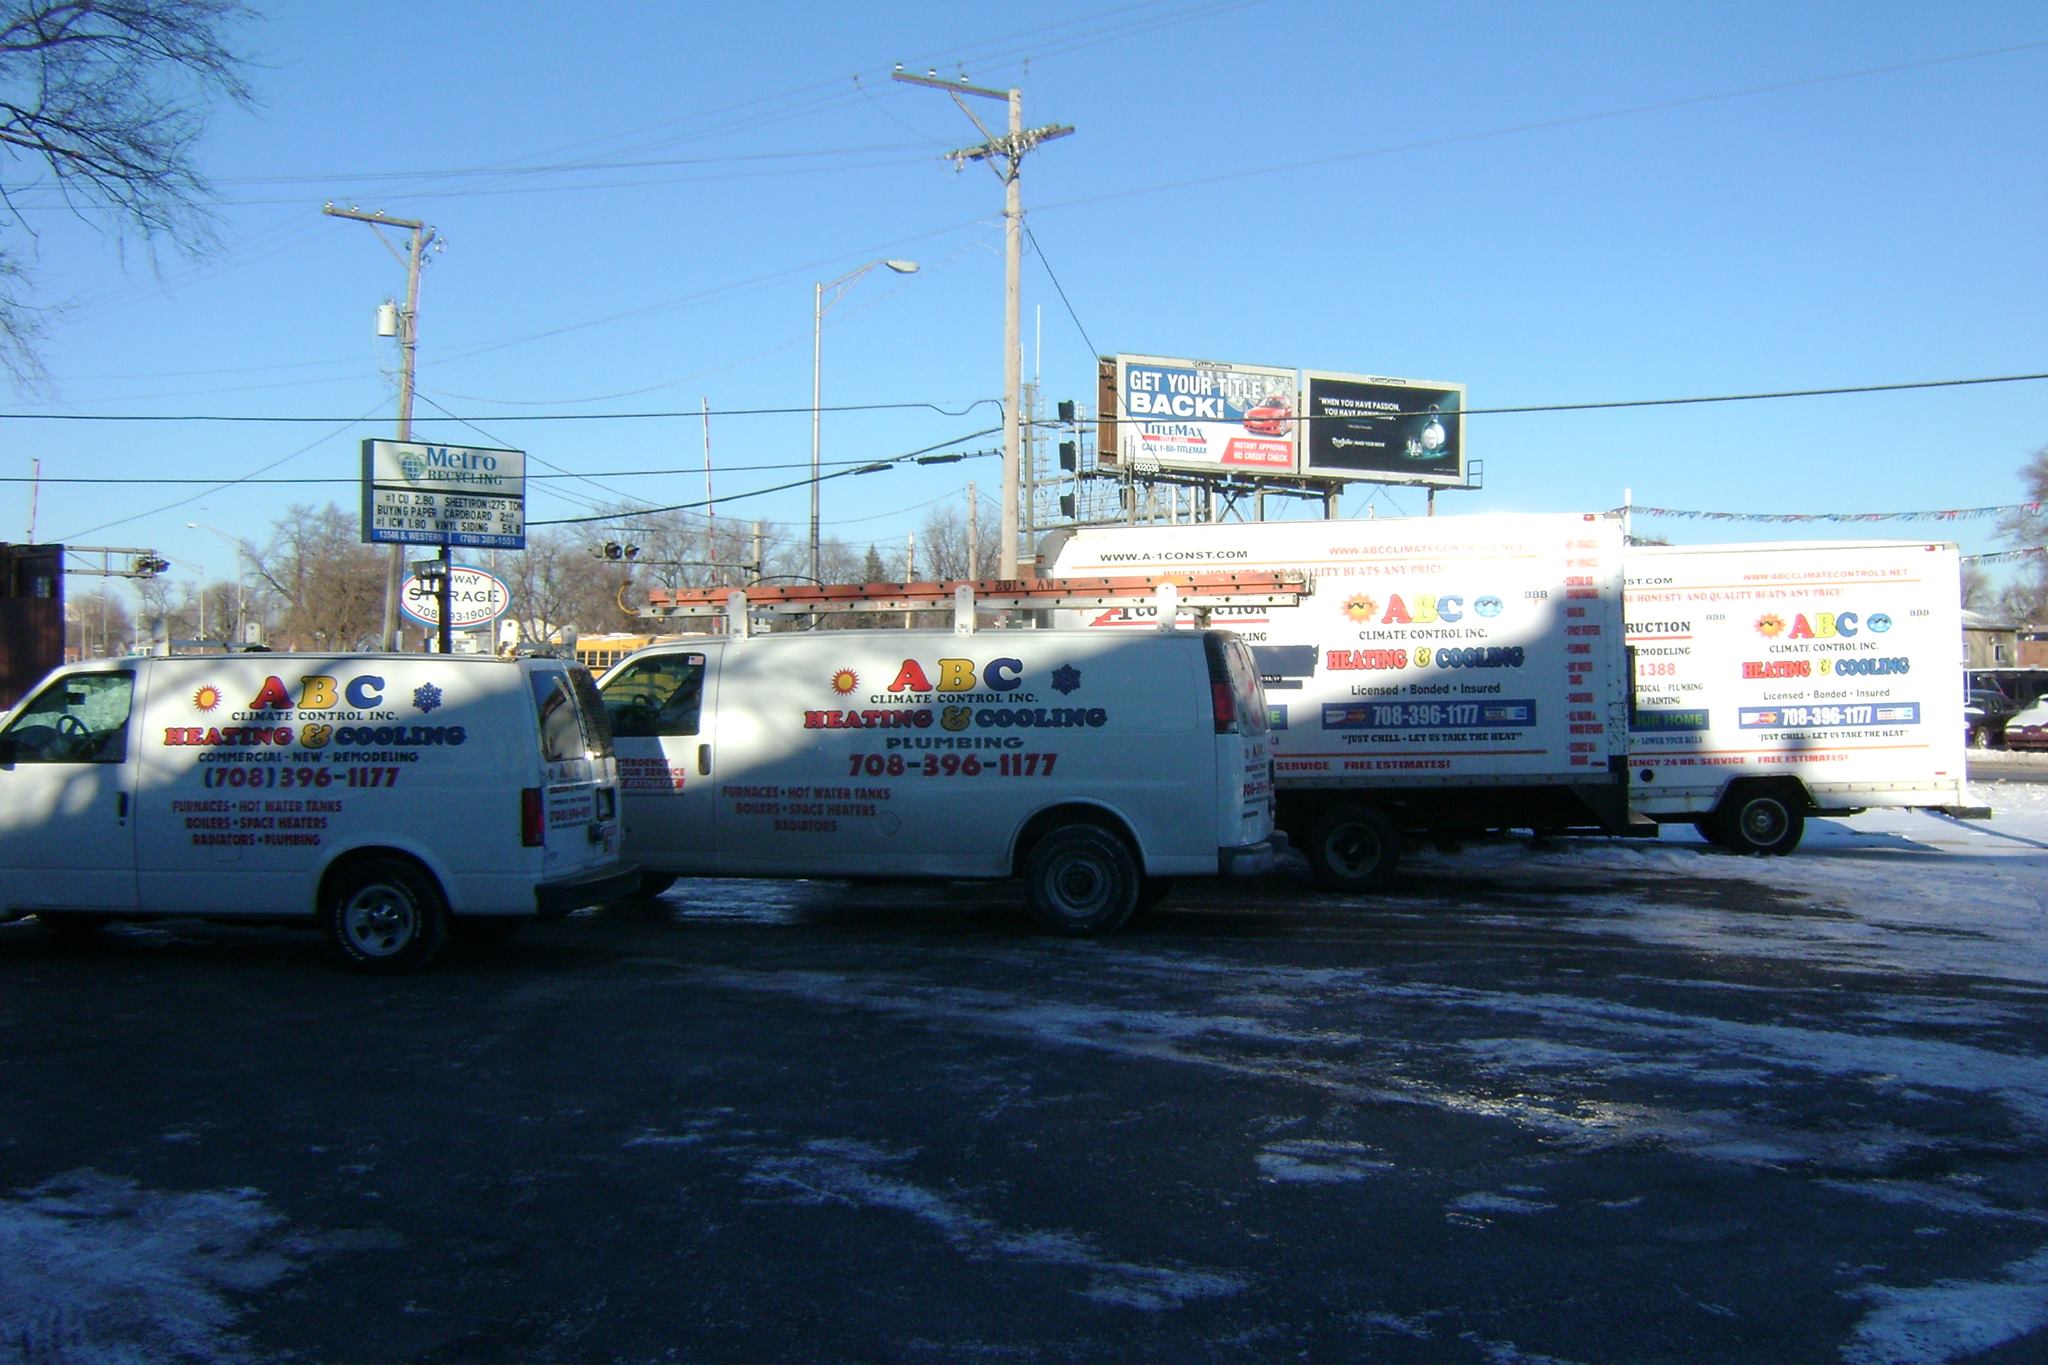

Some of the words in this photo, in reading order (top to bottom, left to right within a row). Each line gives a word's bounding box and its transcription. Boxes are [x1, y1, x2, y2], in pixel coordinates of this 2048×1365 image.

[1130, 370, 1162, 391] GET
[1168, 373, 1212, 396] YOUR
[1217, 378, 1261, 400] TITLE
[1130, 391, 1225, 419] BACK!
[1341, 399, 1354, 408] YOU
[1354, 400, 1372, 409] HAVE
[1324, 408, 1338, 417] YOU
[1142, 443, 1157, 452] CALL
[1233, 441, 1257, 450] INSTANT
[426, 447, 497, 471] Metro
[1233, 451, 1243, 460] NO
[1244, 452, 1266, 461] CREDIT
[1267, 453, 1288, 463] CHECK
[428, 470, 502, 486] RECYCLING
[398, 495, 409, 504] CU
[377, 505, 409, 516] BUYING
[411, 507, 437, 519] PAPER
[444, 509, 492, 521] CARDBOARD
[434, 520, 457, 532] VINYL
[461, 522, 489, 533] SIDING
[409, 532, 443, 542] WESTERN
[1100, 550, 1248, 562] WWW.A-1CONST.COM
[1343, 565, 1380, 577] BEATS
[1382, 565, 1407, 576] ANY
[453, 574, 481, 586] WAY
[409, 588, 501, 603] SRAGE
[1637, 593, 1682, 603] HONESTY
[1686, 592, 1708, 602] AND
[1710, 590, 1752, 601] QUALITY
[1755, 589, 1786, 600] BEATS
[1790, 588, 1811, 599] ANY
[1381, 593, 1464, 624] ABC
[1788, 611, 1859, 640] ABC
[1359, 630, 1408, 641] CLIMATE
[1410, 629, 1463, 640] CONTROL
[1465, 628, 1488, 638] INC.
[1635, 647, 1691, 656] EMODELING
[1769, 644, 1811, 654] CLIMATE
[1813, 642, 1858, 652] CONTROL
[1860, 641, 1880, 651] INC.
[1327, 649, 1408, 671] HEATING
[1414, 646, 1431, 667] &
[1435, 646, 1525, 669] COOLING
[1639, 663, 1676, 676] 1388
[1742, 660, 1811, 679] HEATING
[1835, 656, 1911, 677] COOLING
[887, 657, 1024, 693] ABC
[249, 674, 386, 710] ABC
[1351, 684, 1399, 696] Licensed
[1410, 684, 1450, 695] Bonded
[1460, 683, 1501, 694] Insured
[1763, 691, 1804, 701] Licensed
[1813, 689, 1848, 700] Bonded
[1856, 688, 1891, 698] Insured
[870, 694, 932, 704] CLIMATE
[937, 693, 1004, 704] CONTROL
[1008, 693, 1039, 703] INC.
[1646, 696, 1681, 705] PAINTING
[232, 711, 293, 721] CLIMATE
[299, 711, 364, 721] CONTROL
[369, 711, 399, 721] INC.
[803, 709, 934, 730] HEATING
[940, 705, 972, 732] &
[974, 707, 1108, 728] COOLING
[1373, 704, 1479, 726] 708-396-1177
[1781, 705, 1873, 727] 708-396-1177
[164, 726, 295, 746] HEATING
[301, 723, 334, 749] &
[335, 726, 467, 746] COOLING
[1371, 733, 1401, 743] CHILL
[1409, 733, 1427, 743] LET
[1429, 733, 1440, 743] US
[1441, 732, 1466, 742] TAKE
[1468, 732, 1488, 742] THE
[1780, 732, 1806, 741] CHILL
[1812, 731, 1829, 740] LET
[1830, 731, 1840, 740] US
[1840, 730, 1862, 739] TAKE
[1863, 729, 1882, 739] THE
[886, 736, 1024, 750] PLUMBING
[198, 752, 282, 763] COMMERCIAL
[292, 752, 322, 763] NEW
[333, 752, 419, 762] REMODELING
[1664, 758, 1678, 767] 24
[1701, 755, 1746, 766] SERVICE
[1757, 755, 1783, 765] FREE
[849, 753, 1058, 777] 708-396-1177
[1276, 761, 1330, 771] SERVICE
[1344, 760, 1374, 770] FREE
[722, 786, 779, 800] FURNACES
[788, 787, 810, 800] HOT
[813, 787, 852, 800] WATER
[855, 788, 891, 801] TANKS
[172, 800, 229, 813] FURNACES
[239, 801, 261, 813] HOT
[265, 801, 304, 813] WATER
[306, 801, 342, 813] TANKS
[735, 803, 781, 816] BOILERS
[789, 804, 824, 816] SPACE
[828, 804, 876, 817] HEATERS
[186, 817, 231, 830] BOILERS
[240, 817, 275, 829] SPACE
[278, 817, 328, 829] HEATERS
[774, 820, 838, 833] RADIATORS
[192, 834, 254, 847] RADIATORS
[264, 834, 320, 846] PLUMBING
